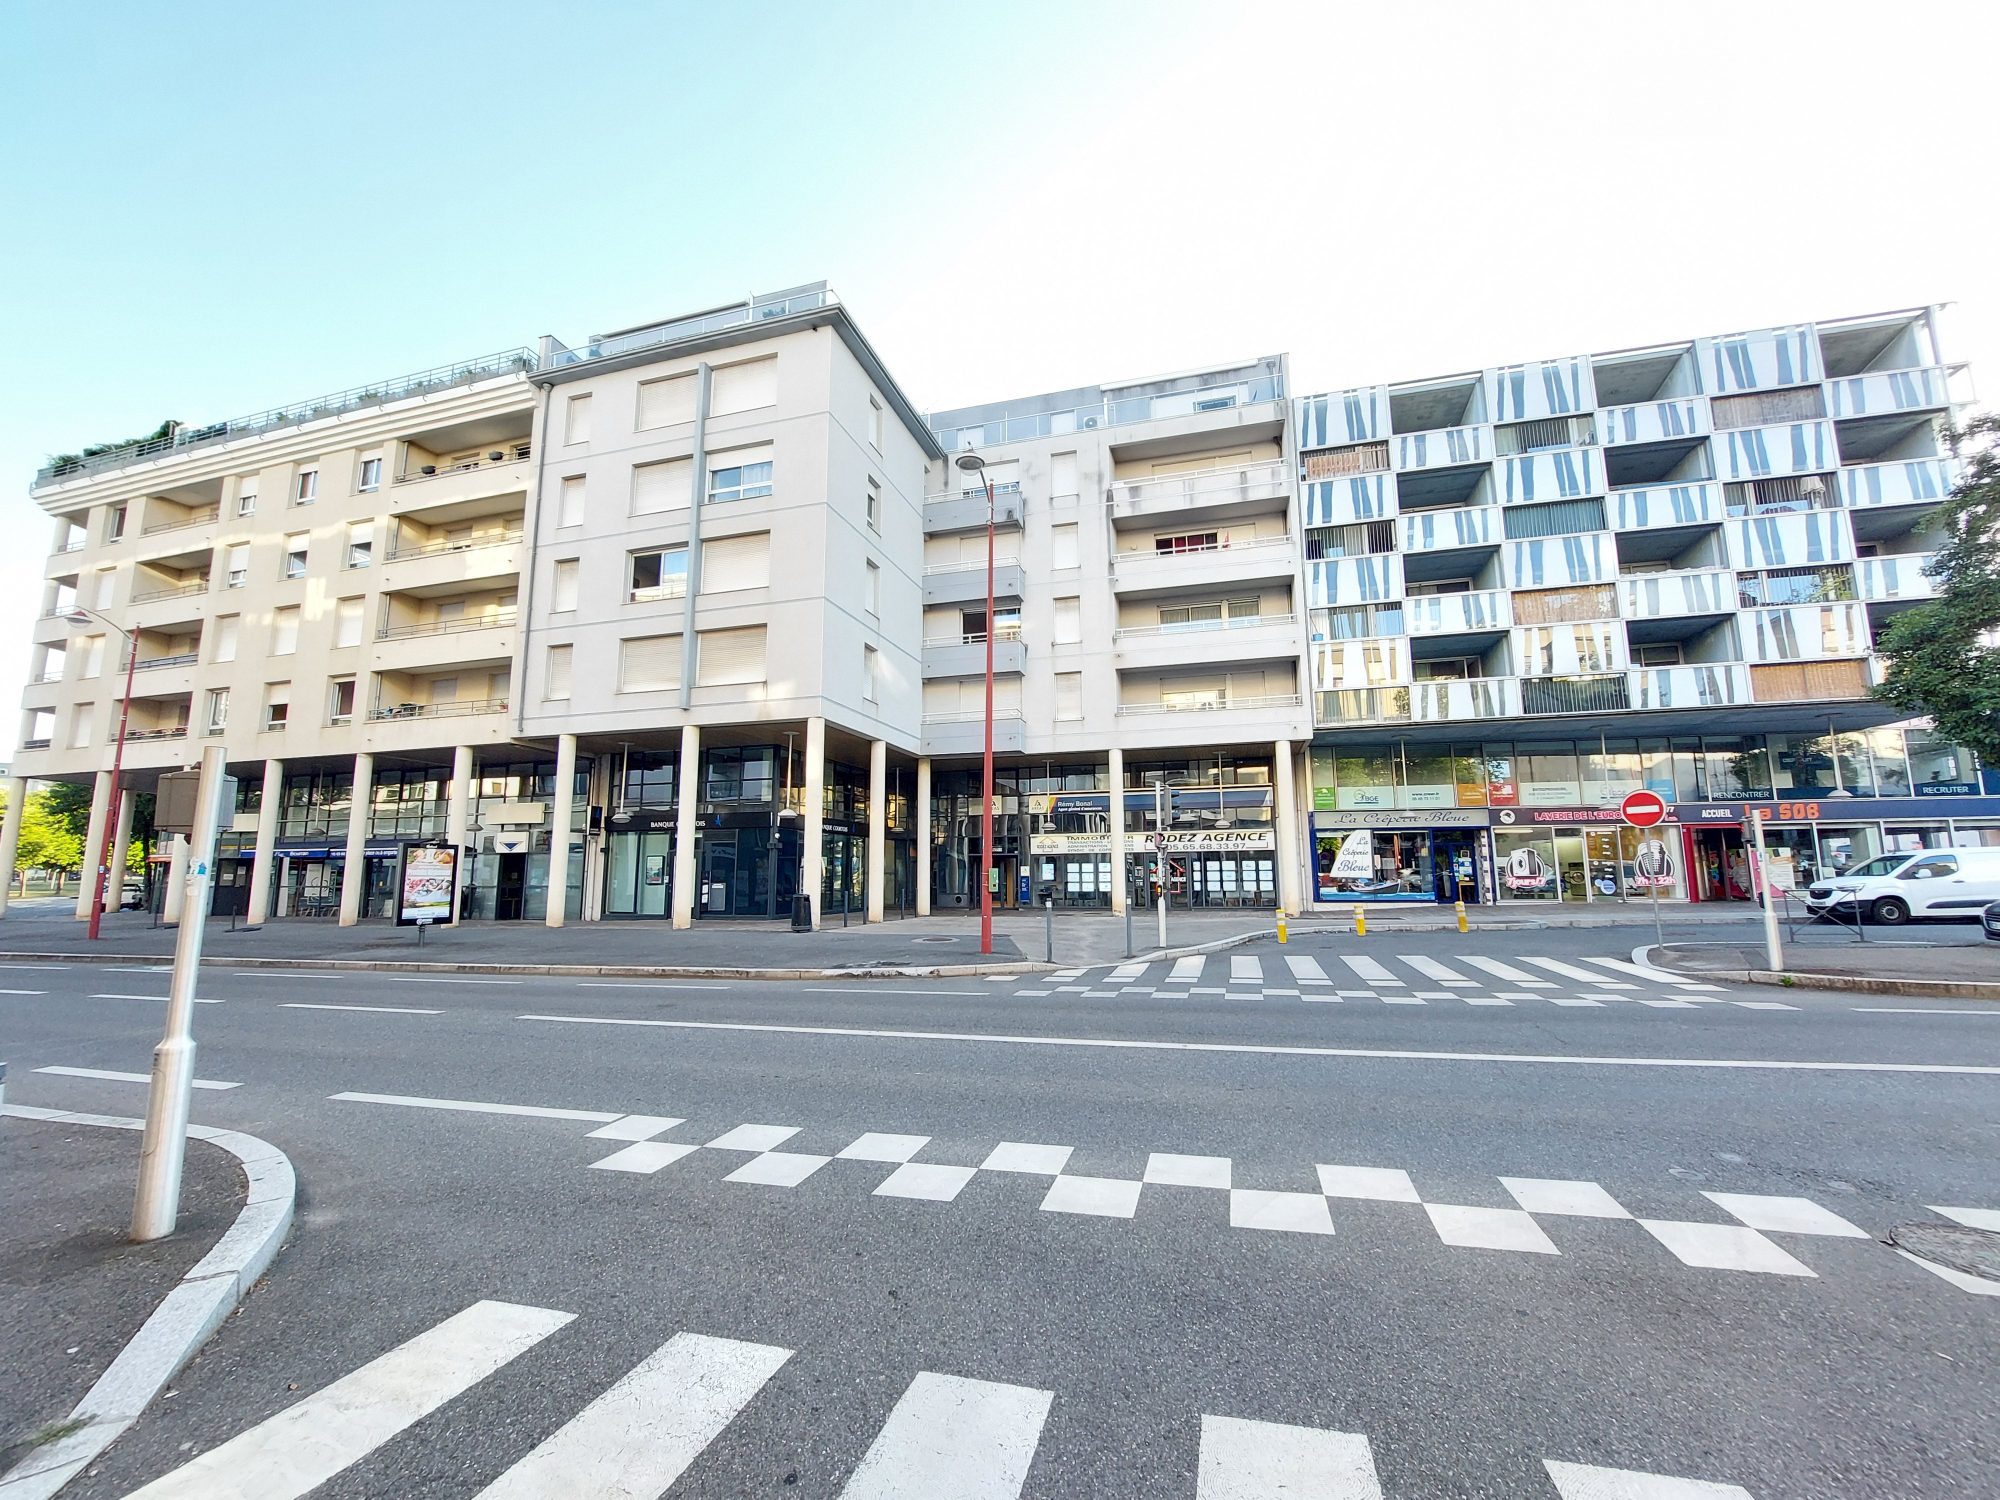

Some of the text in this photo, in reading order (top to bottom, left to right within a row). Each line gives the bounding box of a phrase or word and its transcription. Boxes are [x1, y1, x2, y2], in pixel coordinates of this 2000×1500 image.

[1923, 786, 1969, 794] RECRUTER
[1713, 791, 1770, 799] RENCONTRER
[1334, 813, 1356, 823] La
[1425, 811, 1470, 822] Bleue
[1535, 810, 1622, 821] LAVERIE DE L'EURO
[1702, 809, 1732, 818] ACCUEIL
[650, 821, 675, 829] BANQUE
[1202, 832, 1267, 842] AGENCE
[1357, 837, 1368, 845] La
[1343, 847, 1369, 858] Crêperie
[1338, 860, 1370, 872] Bleue
